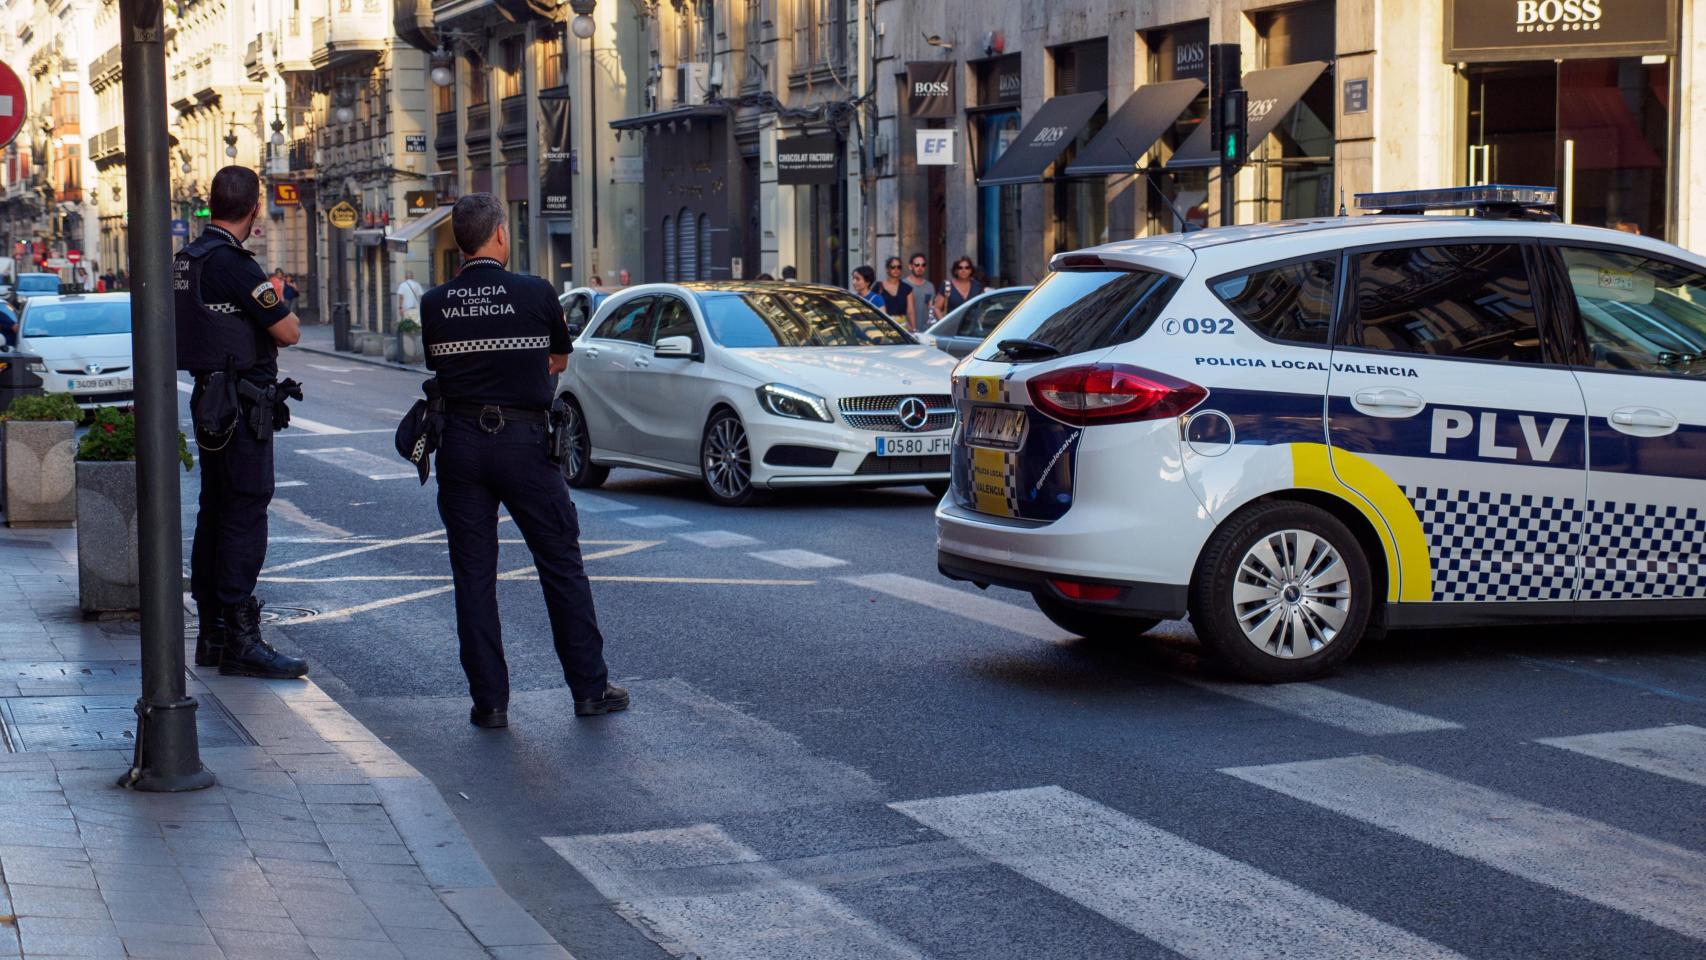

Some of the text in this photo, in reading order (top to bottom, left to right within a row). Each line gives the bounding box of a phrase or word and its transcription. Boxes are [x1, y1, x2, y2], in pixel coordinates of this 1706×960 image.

[1516, 0, 1602, 23] BOSS
[1516, 22, 1600, 32] HUGO BOSS
[1177, 43, 1204, 64] BOSS
[914, 82, 948, 93] BOSS
[1033, 126, 1068, 142] BOSS
[924, 138, 946, 153] EF
[778, 153, 834, 162] CHOCOLAT FACTORY
[447, 285, 507, 298] POLICIA
[462, 297, 492, 305] LOCAL
[441, 304, 515, 319] VALENCIA
[1182, 318, 1235, 335] 092
[1195, 357, 1419, 378] POLICIA LOCAL VALENCIA
[1430, 408, 1570, 462] PLV
[887, 438, 950, 453] 0580 JFH
[976, 482, 1005, 497] VALENCIA
